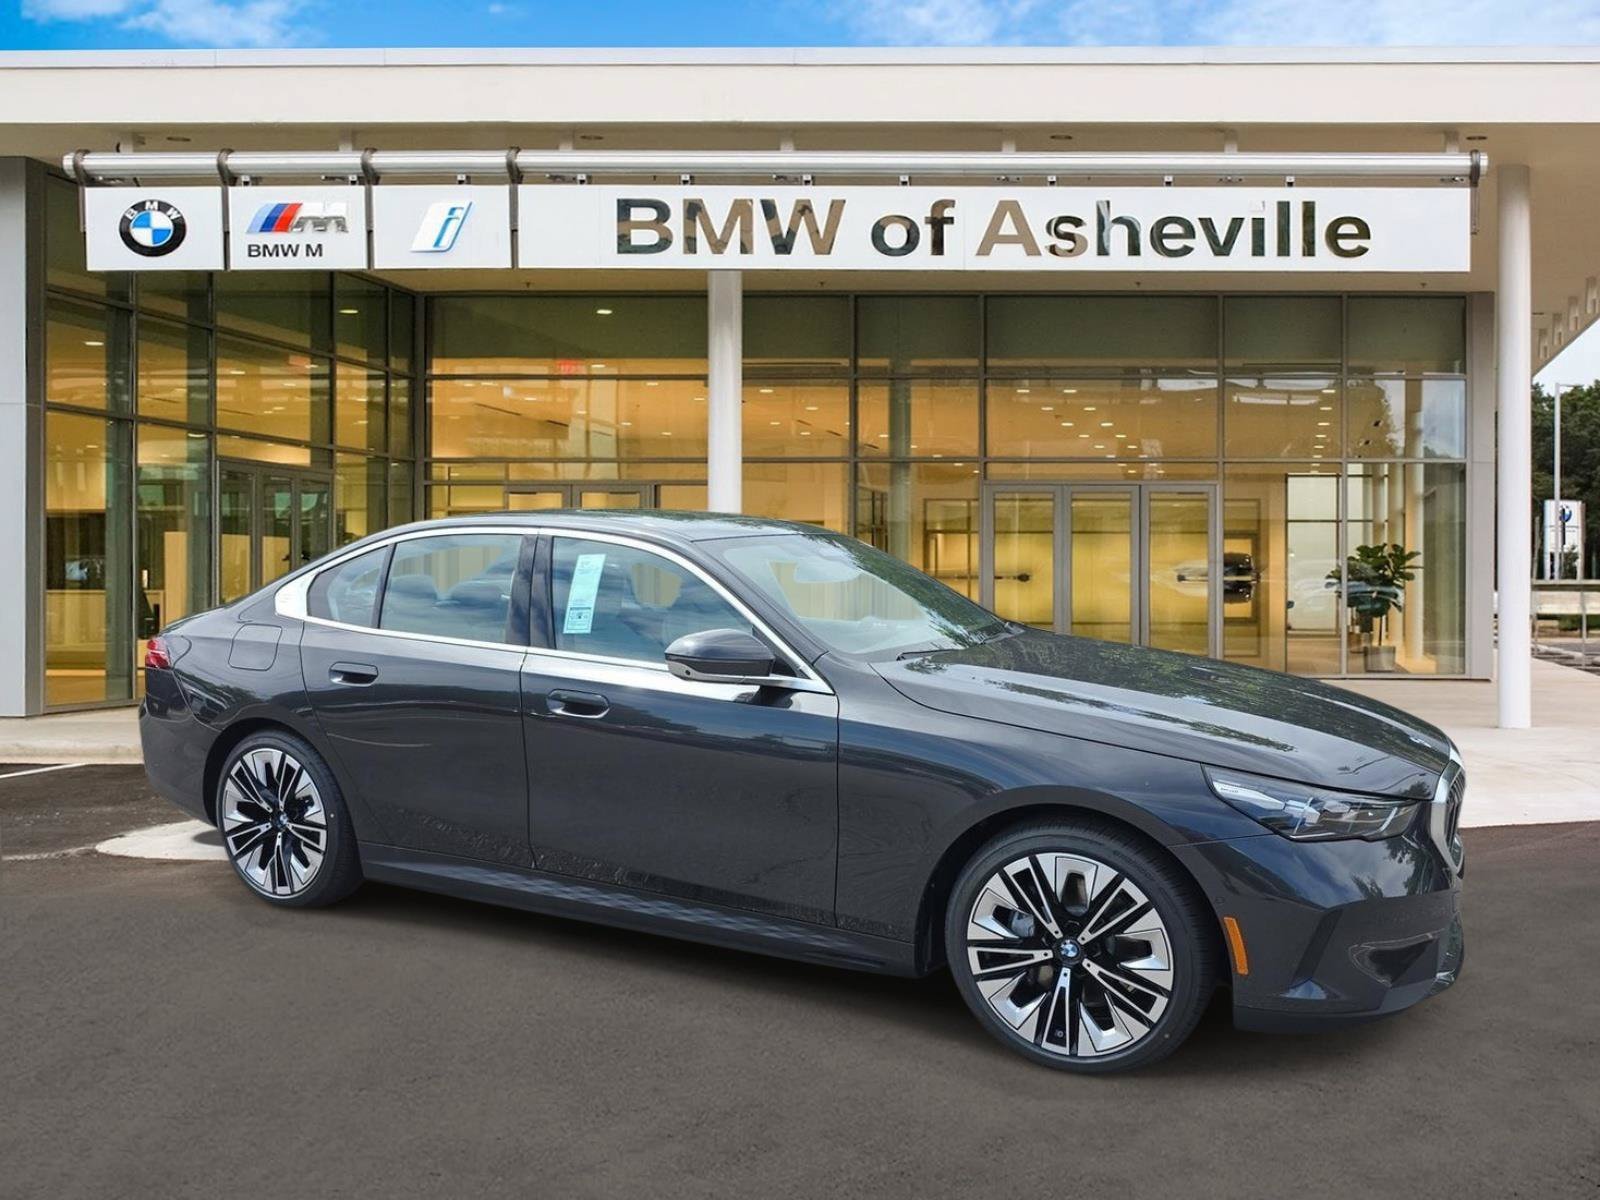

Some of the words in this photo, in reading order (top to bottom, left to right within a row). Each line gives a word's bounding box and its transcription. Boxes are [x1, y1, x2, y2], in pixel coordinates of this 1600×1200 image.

[124, 201, 181, 220] BMW
[617, 199, 847, 256] BMW
[871, 199, 956, 257] of
[975, 199, 1371, 258] Asheville
[247, 244, 300, 258] BMW
[305, 244, 323, 258] M
